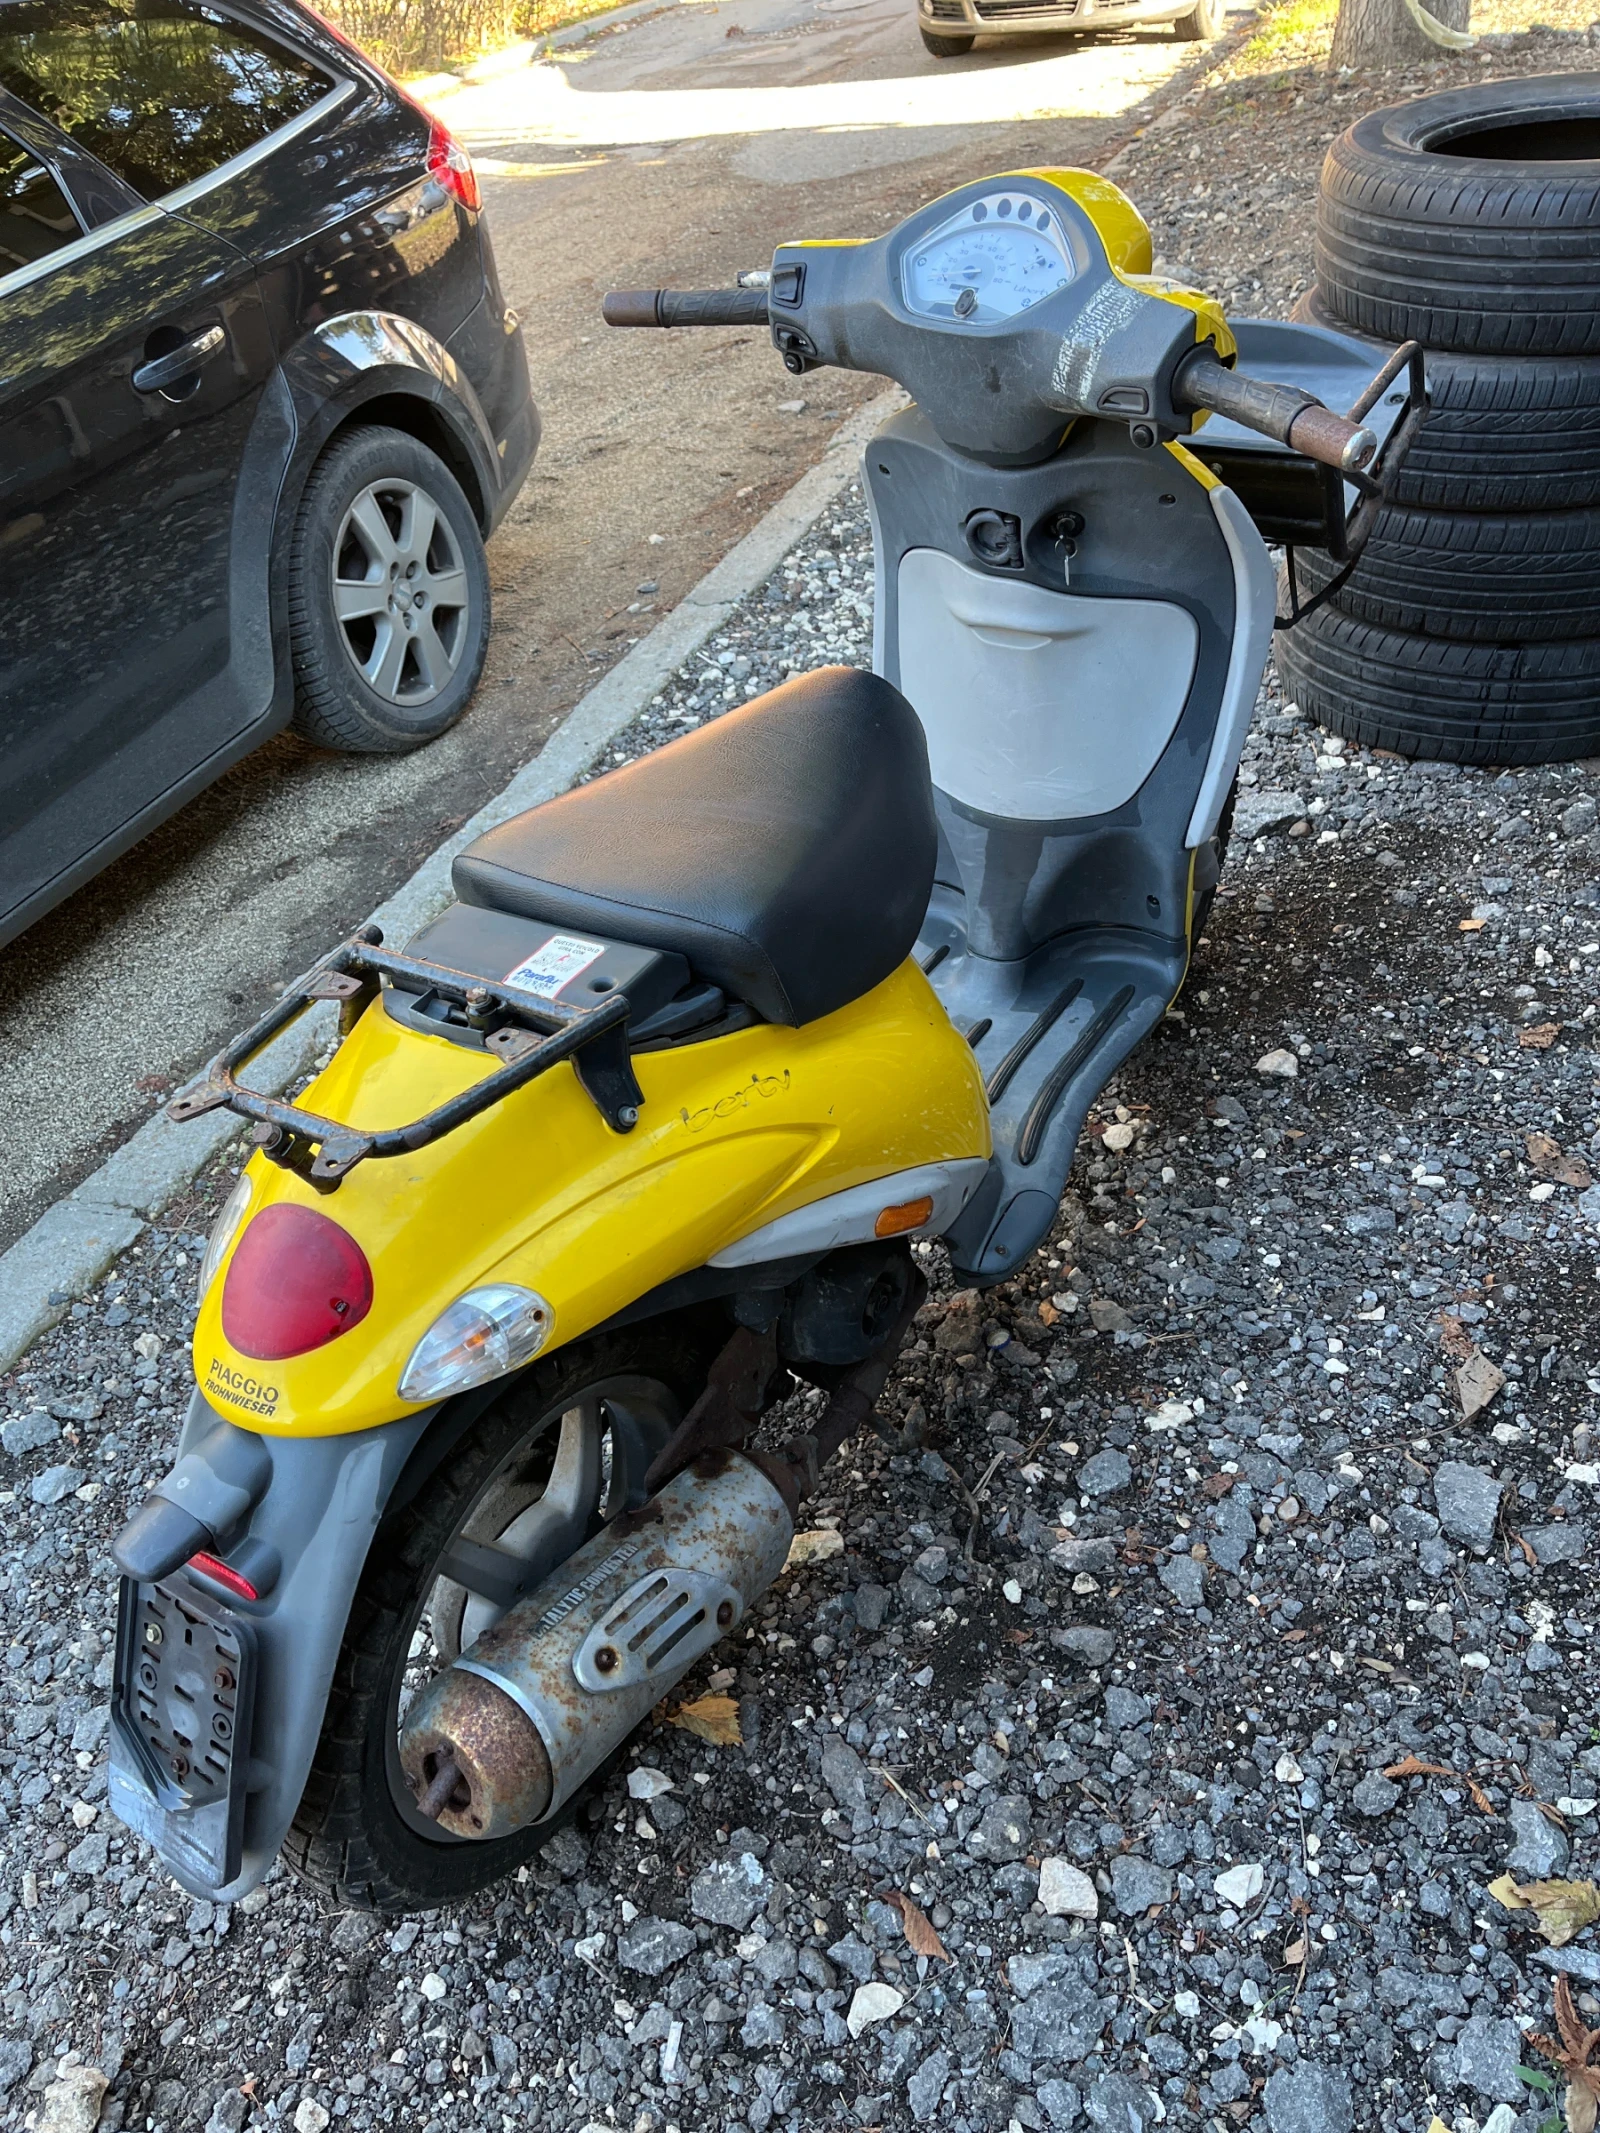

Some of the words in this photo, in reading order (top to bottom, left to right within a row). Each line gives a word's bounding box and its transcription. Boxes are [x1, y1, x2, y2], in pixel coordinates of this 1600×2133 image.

[576, 942, 600, 954] VEICOLO
[517, 968, 560, 985] Paraflu
[204, 1378, 276, 1417] FROHNWIESER
[209, 1358, 279, 1403] PIAGGIO
[579, 1543, 639, 1592] CONVERTER
